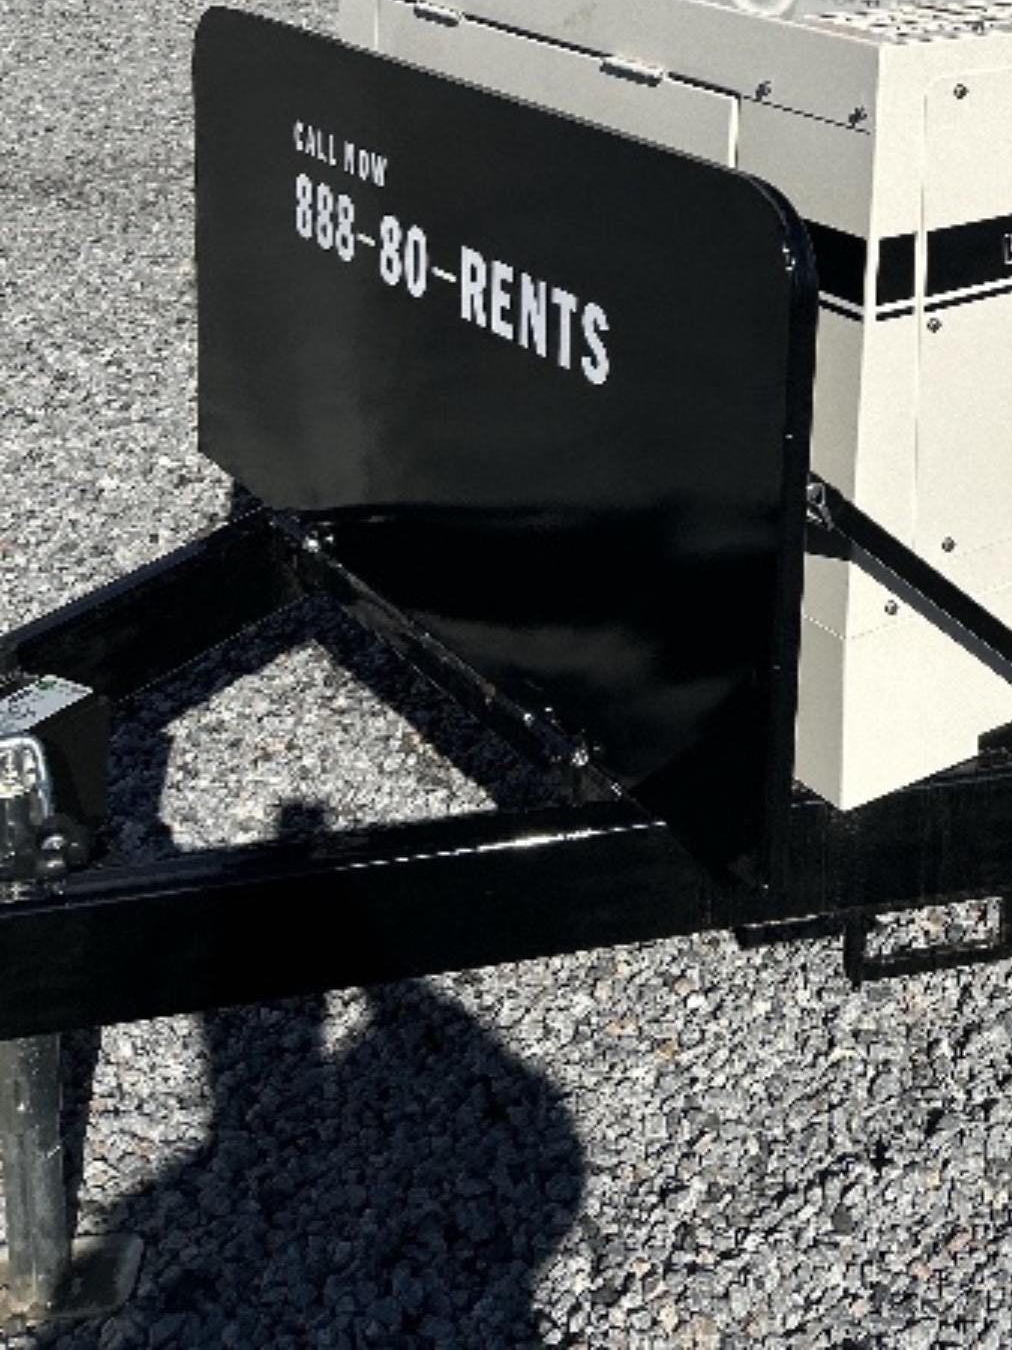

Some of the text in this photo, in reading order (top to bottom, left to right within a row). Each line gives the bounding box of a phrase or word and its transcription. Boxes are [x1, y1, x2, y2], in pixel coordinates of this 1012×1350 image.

[294, 119, 388, 187] CALL NOW
[295, 172, 610, 385] 888-80-RENTS
